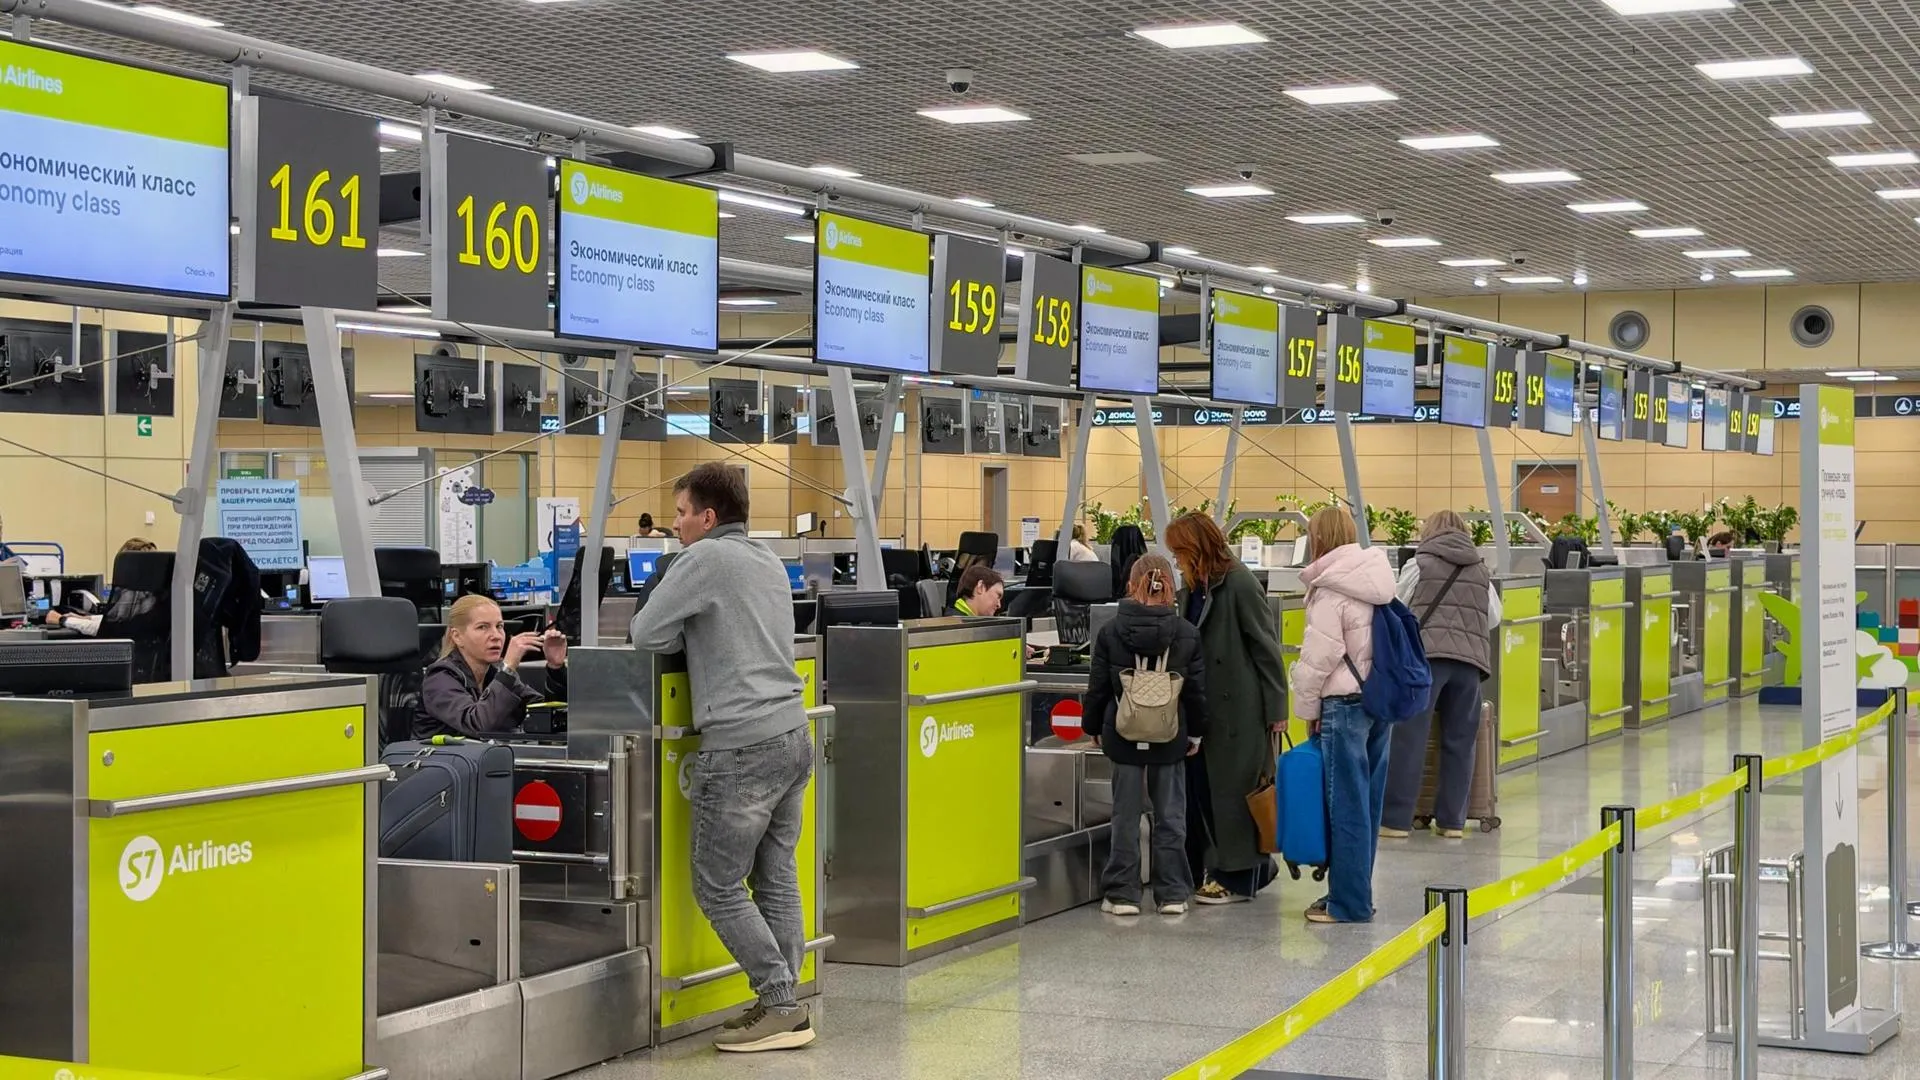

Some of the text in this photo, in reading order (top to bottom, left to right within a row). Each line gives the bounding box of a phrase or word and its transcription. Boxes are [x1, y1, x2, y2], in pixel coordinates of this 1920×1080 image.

[4, 64, 63, 95] Airlines
[0, 151, 196, 197] ономический класс
[0, 183, 121, 216] onomy class
[269, 164, 367, 249] 161
[589, 181, 624, 203] Airlines
[457, 194, 540, 274] 160
[570, 240, 699, 276] Экономический класс
[570, 264, 655, 292] Economy class
[824, 280, 916, 309] Экономический класс
[949, 279, 996, 335] 159
[824, 299, 885, 324] Economy class
[1034, 295, 1071, 348] 158
[1287, 337, 1315, 378] 157
[1337, 343, 1361, 385] 156
[1494, 370, 1513, 403] 155
[1526, 375, 1544, 406] 154
[1633, 391, 1649, 420] 153
[1654, 397, 1667, 423] 152
[221, 487, 296, 495] ПРОВЕРЬТЕ РАЗМЕРЫ
[221, 496, 296, 505] ВАШЕЙ РУЧНОЙ КЛАДИ
[939, 721, 975, 743] Airlines
[167, 839, 253, 875] Airlines
